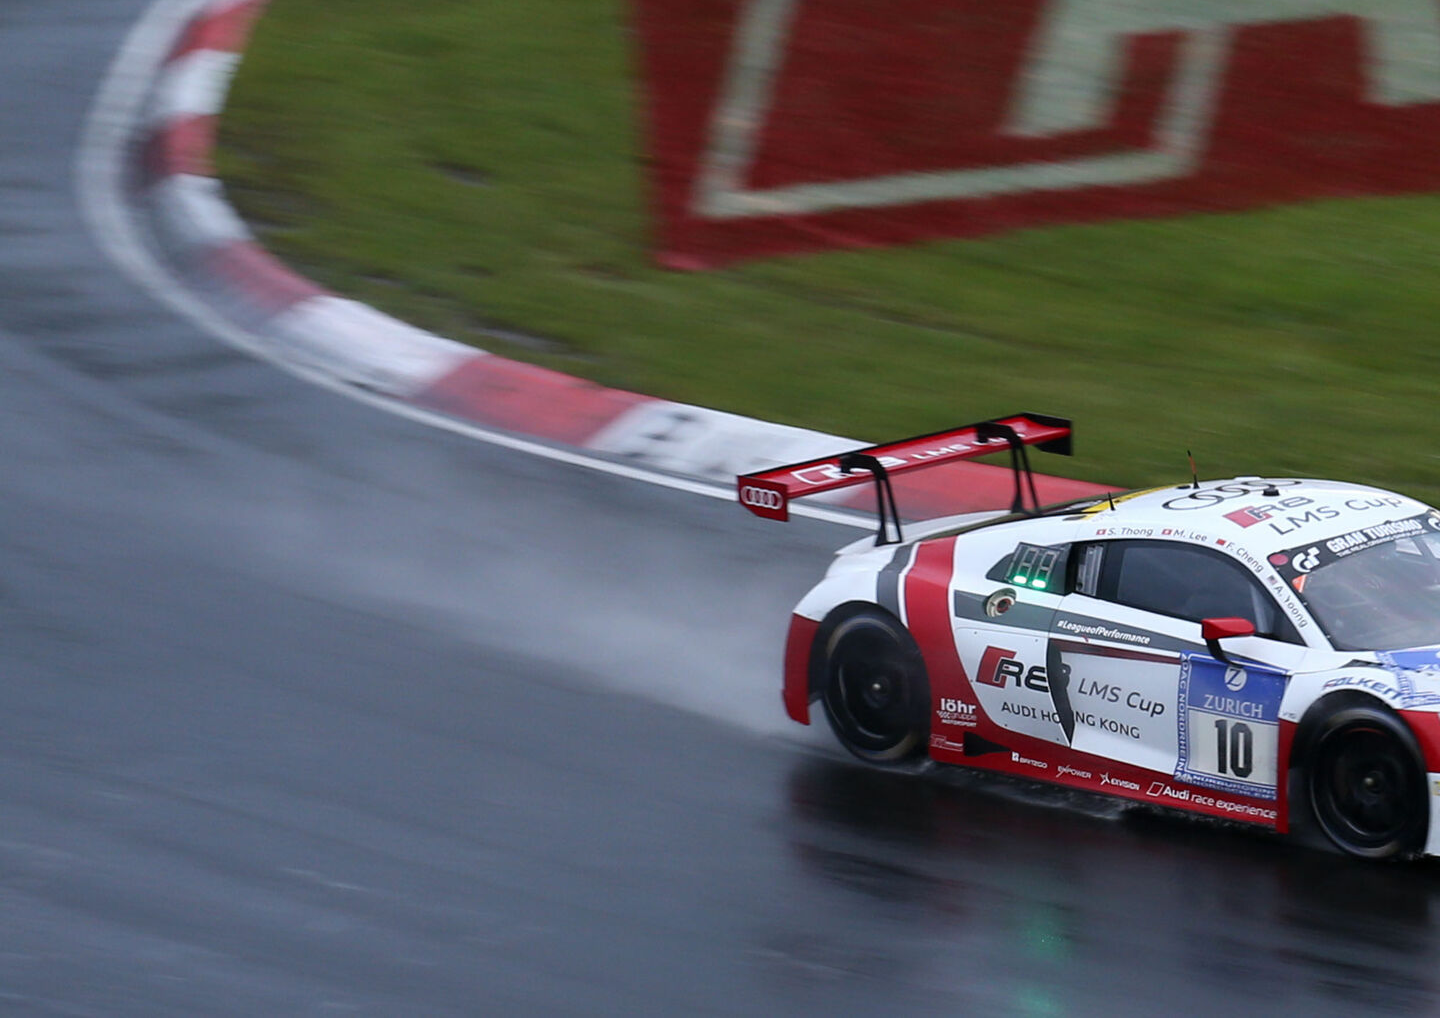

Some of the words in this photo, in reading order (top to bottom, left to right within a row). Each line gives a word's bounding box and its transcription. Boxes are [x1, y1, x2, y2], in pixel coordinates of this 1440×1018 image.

[1107, 527, 1118, 536] S.
[1121, 527, 1153, 537] Thong
[1268, 505, 1341, 535] LMS
[1345, 497, 1402, 512] Cup
[1173, 529, 1187, 539] M.
[1189, 531, 1208, 542] Lee
[1326, 530, 1366, 554] GRAN
[1364, 519, 1423, 541] TURISMO
[1225, 541, 1236, 552] F.
[1235, 547, 1264, 574] Cheng
[1273, 585, 1284, 598] A.
[1283, 594, 1309, 629] Yoong
[1056, 620, 1151, 644] #LeagueofPerformance
[993, 658, 1071, 693] R8
[1078, 678, 1121, 703] LMS
[1126, 691, 1165, 718] Cup
[940, 698, 976, 714] löhr
[1001, 701, 1037, 720] AUDI
[1041, 711, 1096, 728] HONG
[1100, 718, 1141, 739] KONG
[1203, 694, 1263, 719] ZURICH
[1215, 719, 1253, 778] 10
[1163, 786, 1190, 801] Audi
[1190, 792, 1215, 807] race
[1216, 799, 1277, 819] experience
